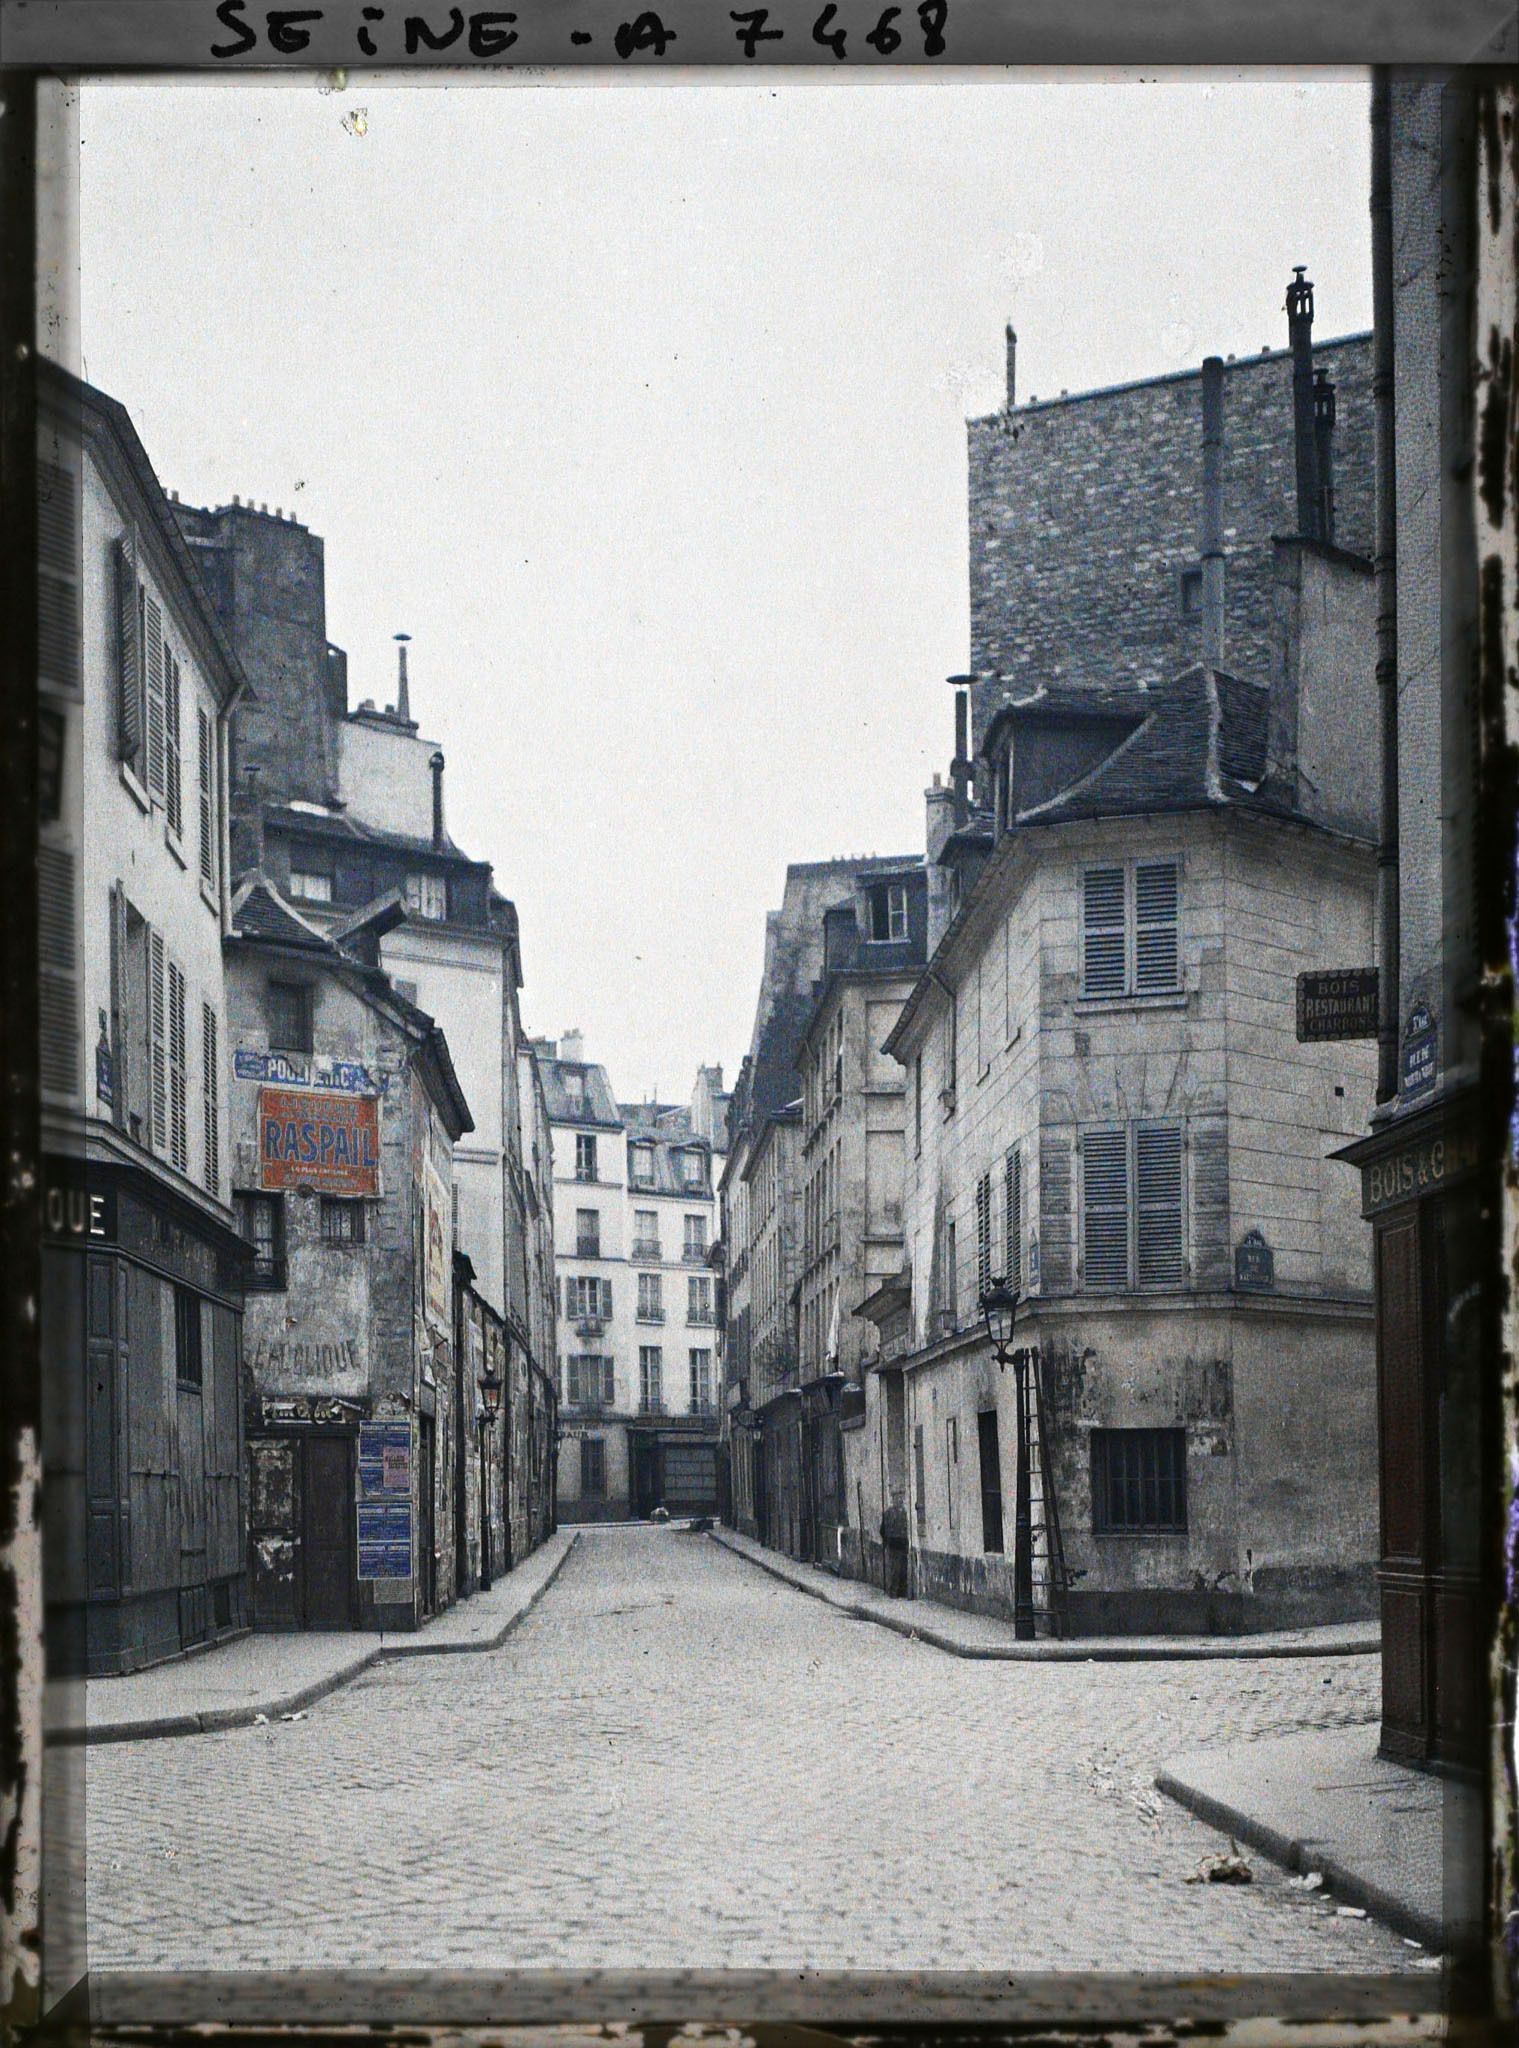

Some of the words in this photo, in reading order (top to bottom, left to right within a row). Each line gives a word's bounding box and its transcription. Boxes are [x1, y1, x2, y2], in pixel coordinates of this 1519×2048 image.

[729, 2, 948, 61] 7468
[1306, 992, 1377, 1019] RESTAURANT
[1317, 979, 1360, 995] BOIS
[265, 1118, 377, 1168] RASPAIL
[1370, 1154, 1414, 1203] BOIS
